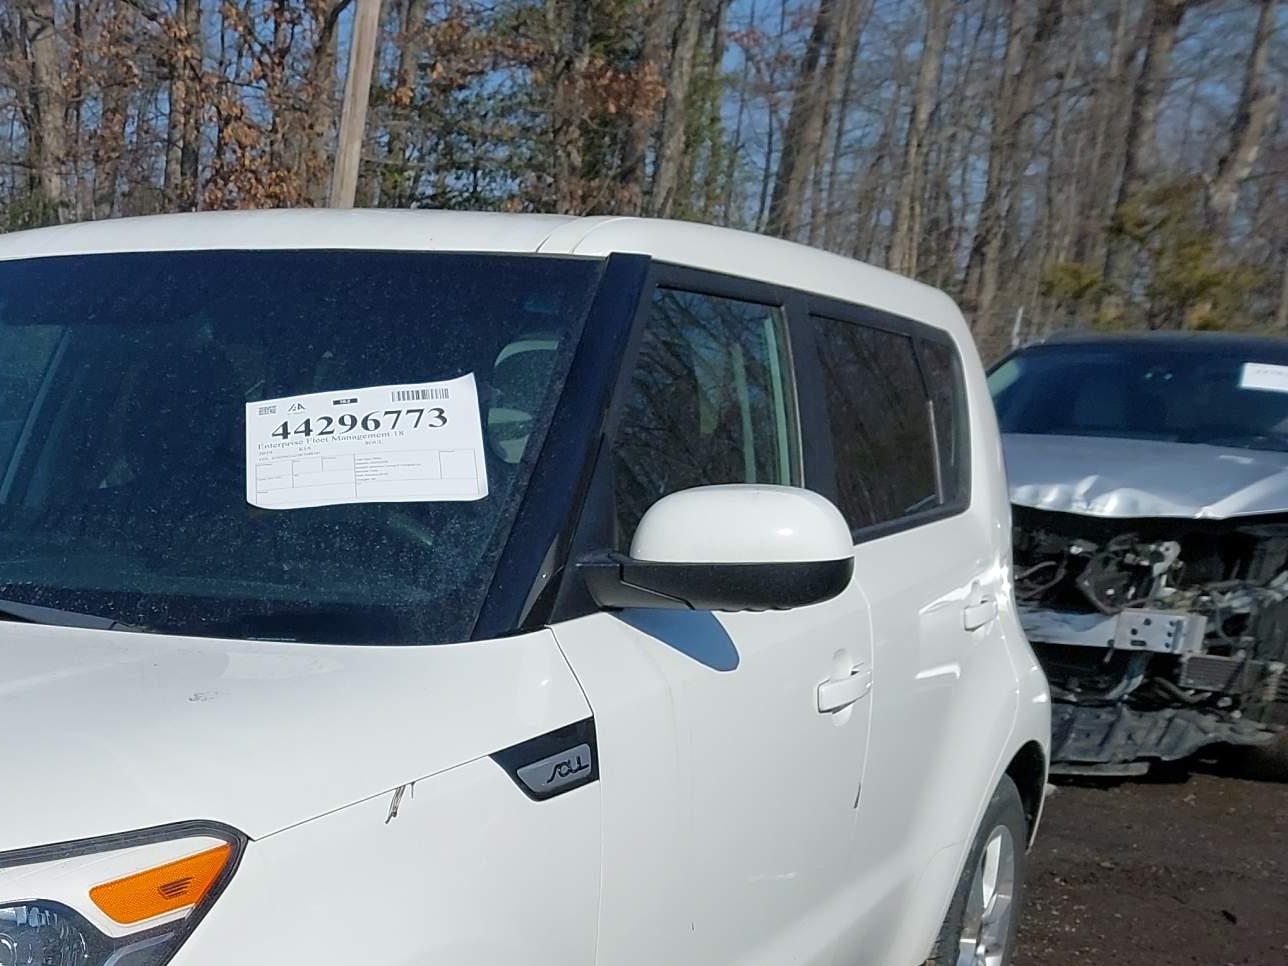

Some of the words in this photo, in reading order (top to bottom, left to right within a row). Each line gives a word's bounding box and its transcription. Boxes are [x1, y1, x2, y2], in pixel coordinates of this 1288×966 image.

[271, 407, 449, 440] 44296773
[257, 439, 304, 450] Enterprise
[306, 437, 329, 445] Fleet
[332, 432, 390, 443] Management
